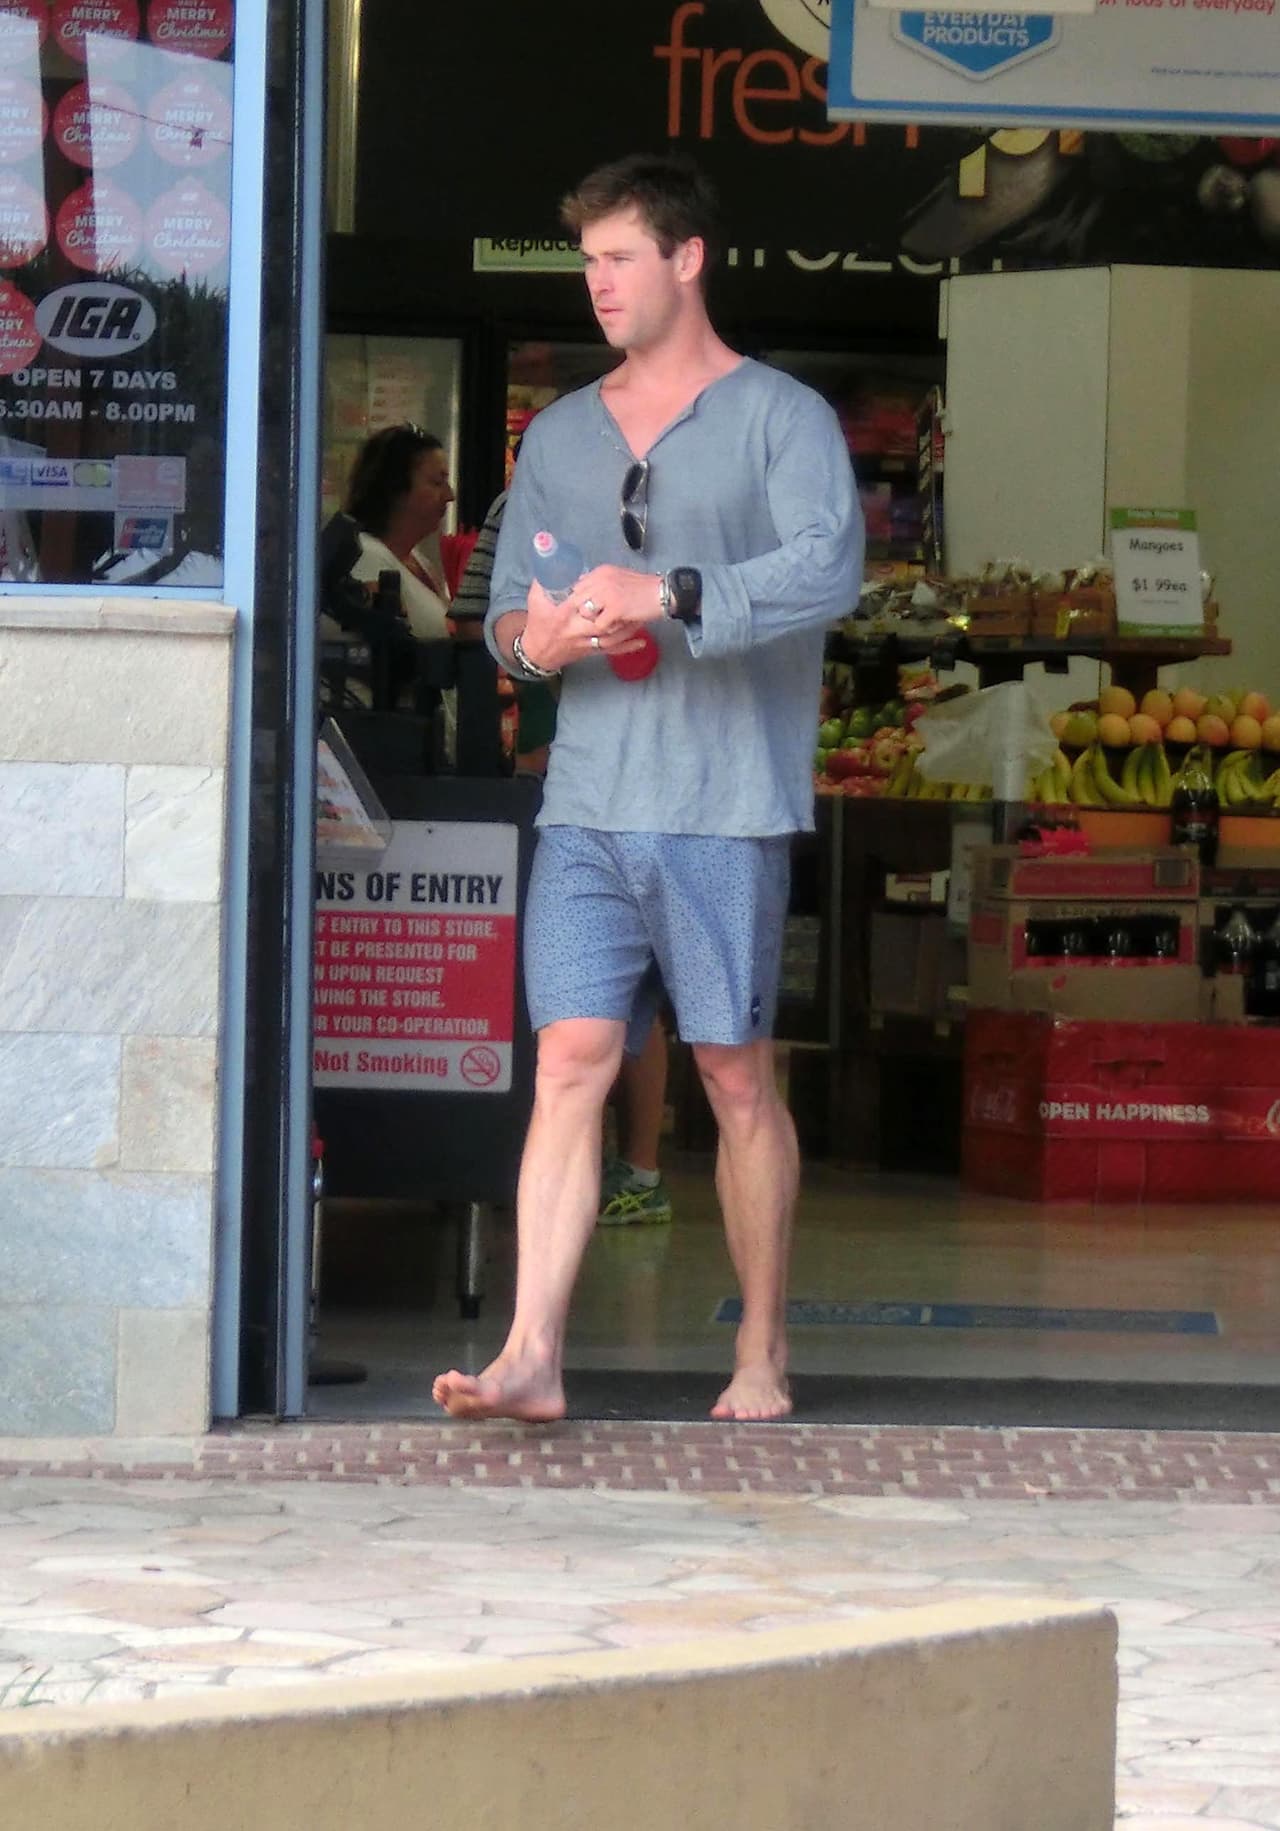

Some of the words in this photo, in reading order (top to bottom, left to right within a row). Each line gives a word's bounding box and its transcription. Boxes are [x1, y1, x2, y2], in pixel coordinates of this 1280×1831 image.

[72, 7, 120, 21] MERRY
[167, 8, 215, 21] MERRY
[1193, 0, 1276, 15] everyday
[923, 11, 1027, 26] EVERYDAY
[156, 21, 228, 39] Christmas
[923, 26, 1030, 47] PRODUCTS
[653, 2, 920, 148] fres
[73, 112, 122, 125] MERRY
[165, 109, 214, 122] MERRY
[75, 215, 124, 228] MERRY
[164, 217, 213, 230] MERRY
[153, 230, 224, 248] Christmas
[490, 238, 580, 256] Replace
[48, 296, 142, 340] IGA
[12, 367, 82, 388] OPEN
[90, 369, 105, 389] 7
[112, 369, 178, 391] DAYS
[105, 402, 196, 423] 8.00PM
[37, 464, 68, 477] VISA
[1128, 539, 1184, 554] Mangoes
[316, 872, 354, 900] NS
[366, 873, 401, 901] OF
[410, 873, 503, 904] ENTRY
[331, 917, 378, 935] ENTRY
[383, 918, 401, 936] TO
[407, 919, 441, 937] THIS
[331, 941, 349, 957] BE
[355, 942, 443, 959] PRESENTED
[448, 944, 477, 961] FOR
[329, 965, 371, 982] UPON
[376, 967, 445, 984] REQUEST
[360, 989, 388, 1007] THE
[392, 991, 446, 1009] STORE.
[332, 1016, 372, 1033] YOUR
[376, 1017, 489, 1036] CO-OPERATION
[357, 1051, 448, 1077] Smoking
[1038, 1103, 1090, 1120] OPEN
[1096, 1104, 1210, 1123] HAPPINESS
